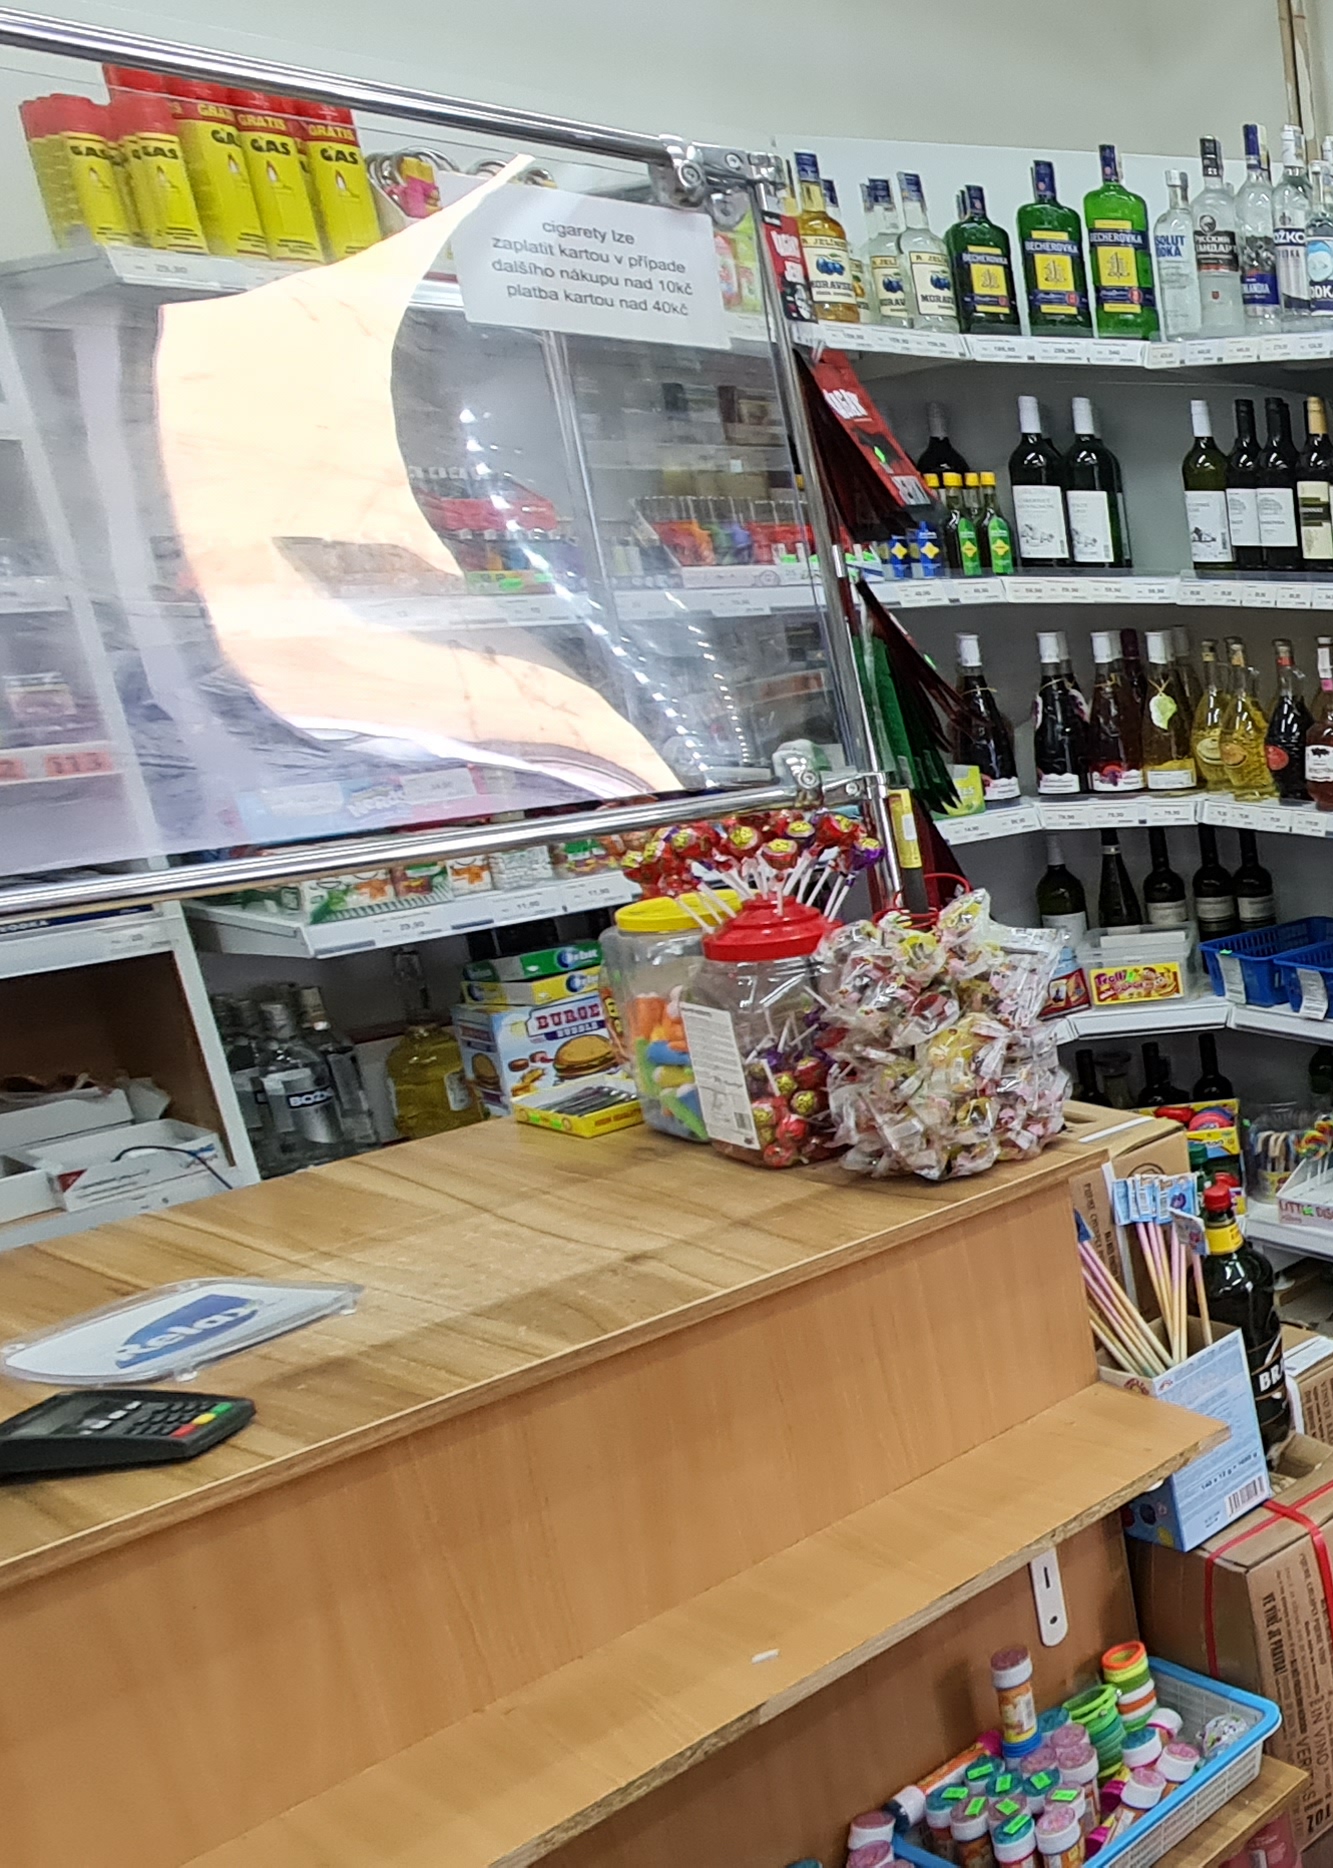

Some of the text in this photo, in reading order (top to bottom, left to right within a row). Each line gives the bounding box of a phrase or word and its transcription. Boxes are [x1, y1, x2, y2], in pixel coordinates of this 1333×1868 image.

[211, 129, 241, 148] GA
[250, 137, 291, 157] GAS
[320, 148, 359, 165] GAS
[542, 220, 635, 245] cigarety lze
[1274, 230, 1305, 244] OŽKO
[492, 237, 554, 257] zaplatit
[559, 243, 609, 264] kartou
[628, 252, 686, 274] případe
[492, 257, 693, 296] dalšího nákupu nad 10kč
[507, 283, 689, 316] platba kartou nad 40kč
[536, 1003, 600, 1030] BURGE
